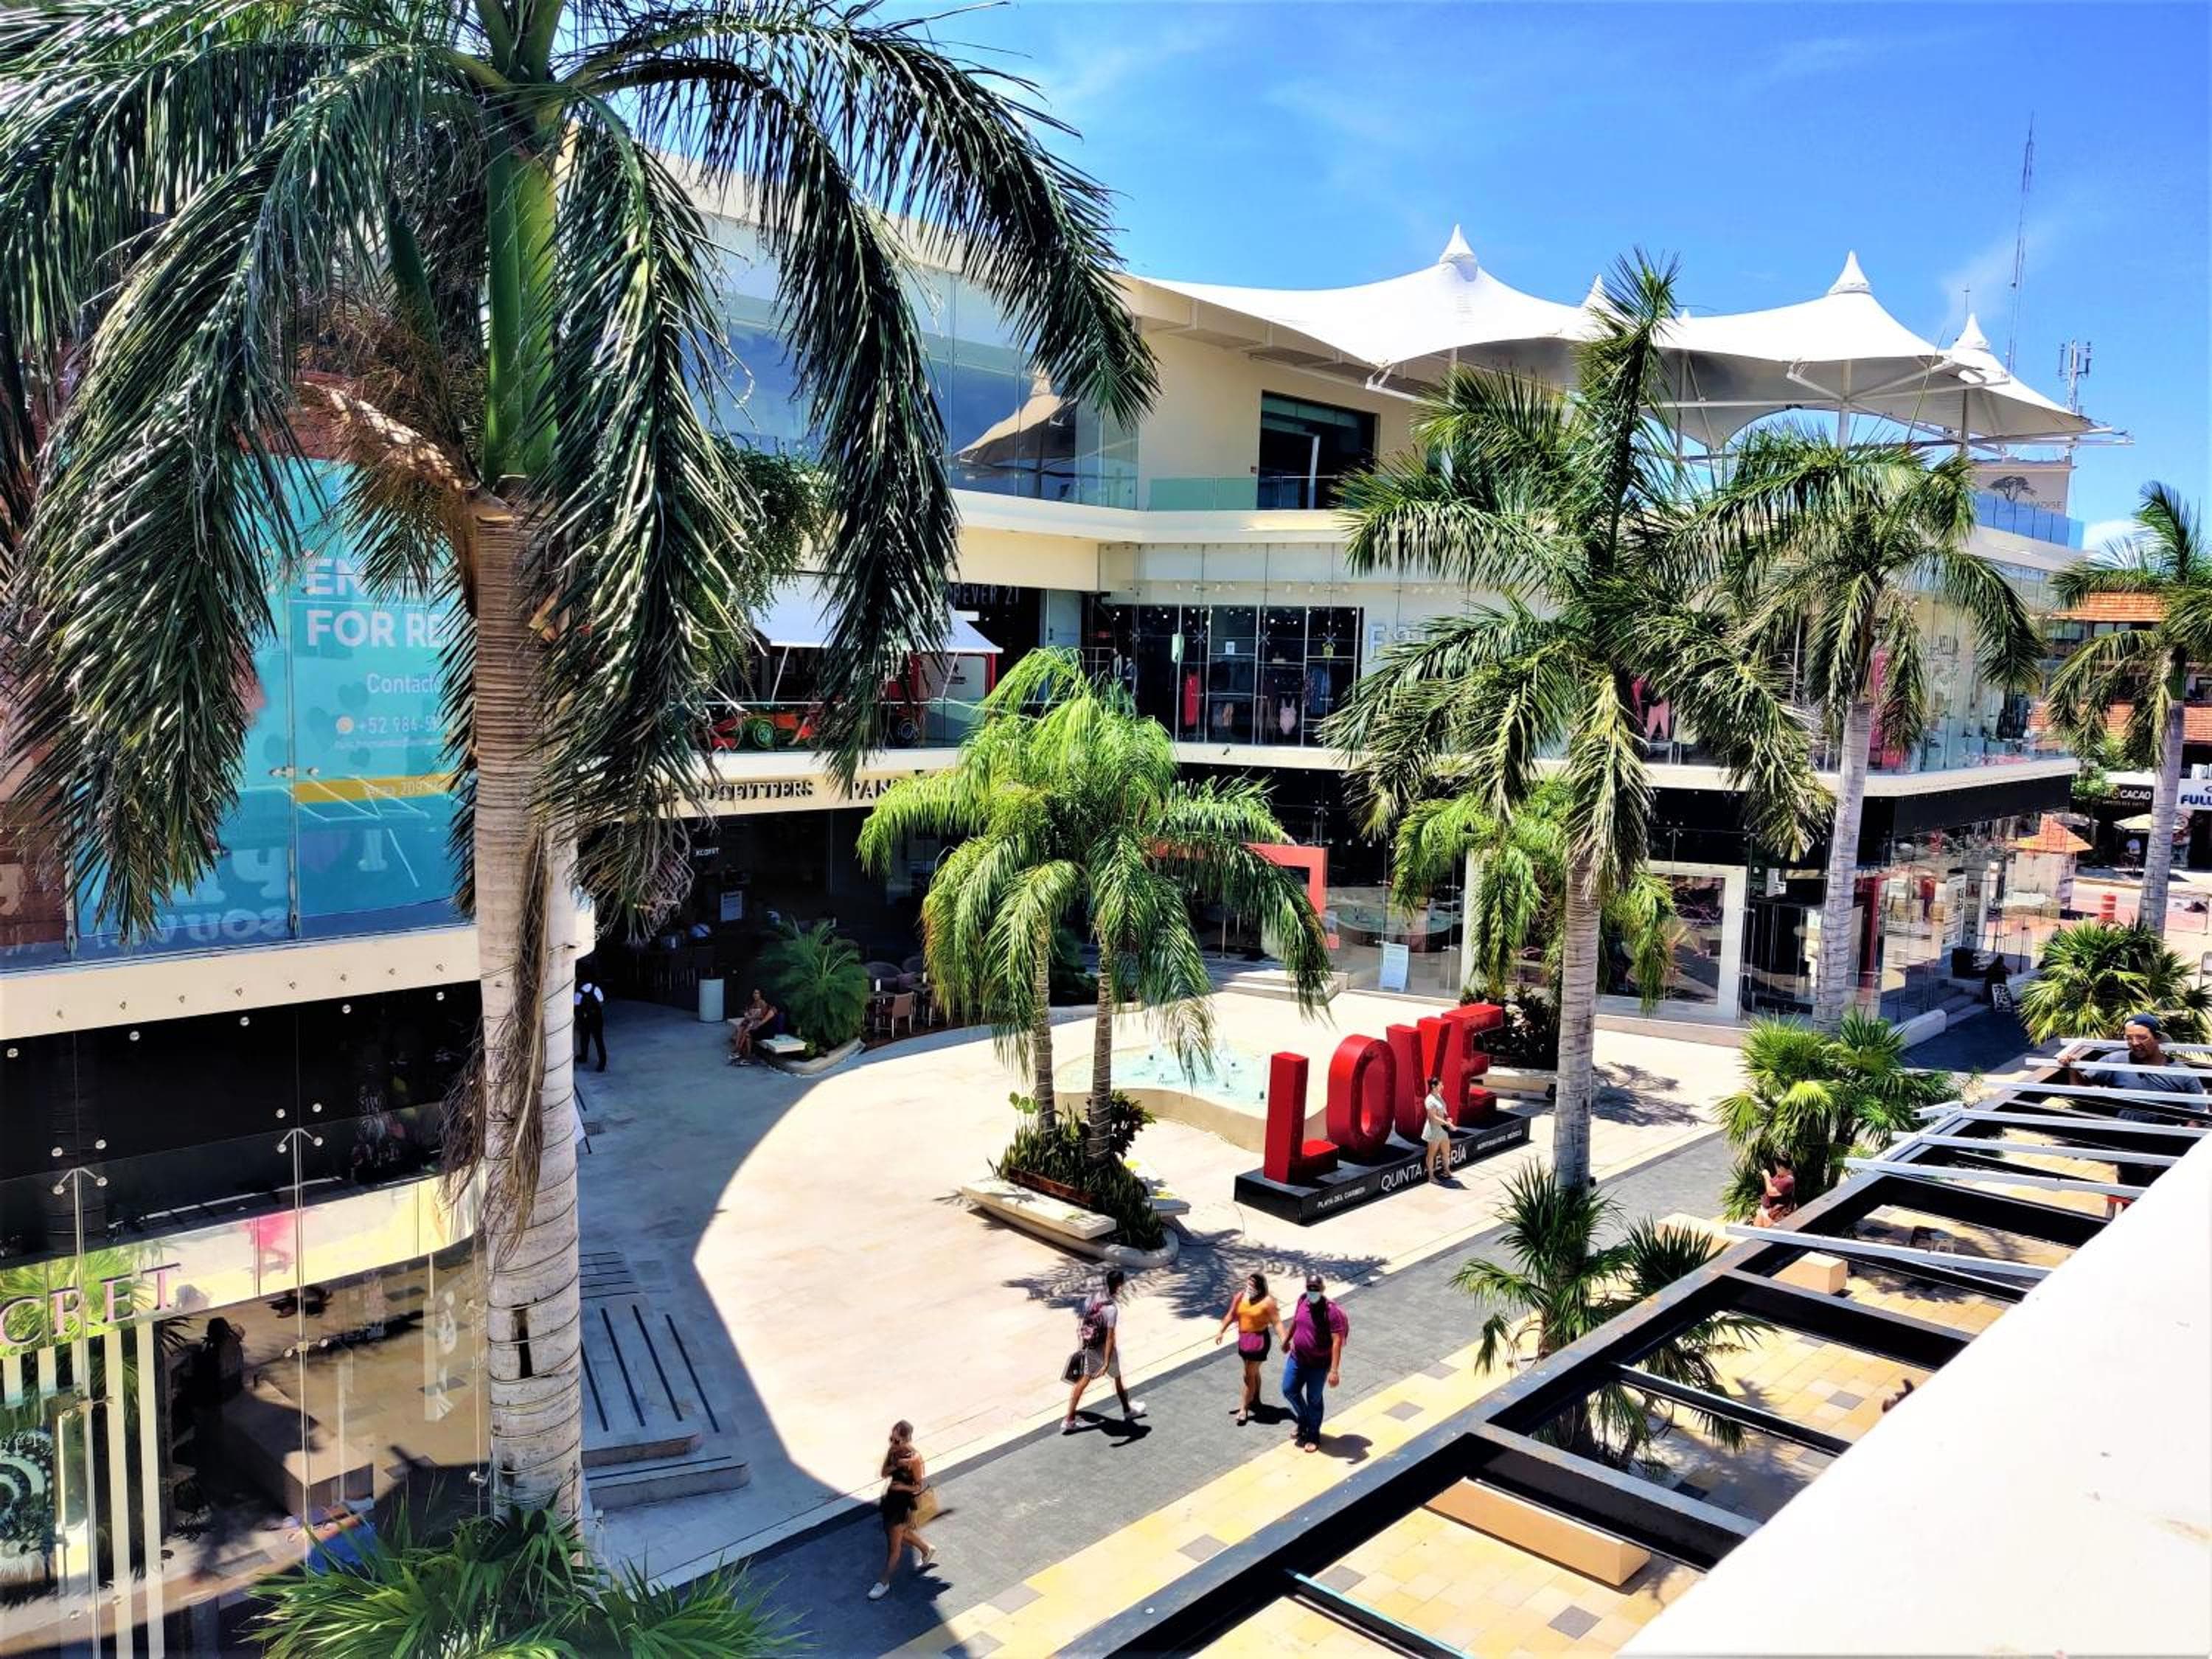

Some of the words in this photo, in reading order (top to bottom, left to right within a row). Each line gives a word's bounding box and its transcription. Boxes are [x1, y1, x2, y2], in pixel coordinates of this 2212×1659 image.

[306, 610, 397, 648] FOR
[701, 780, 814, 801] UTFITTERS
[2120, 790, 2152, 801] CACAO
[1264, 1004, 1504, 1183] LOVE
[1381, 1162, 1422, 1192] QUINTA
[1423, 1144, 1467, 1175] ERÍA
